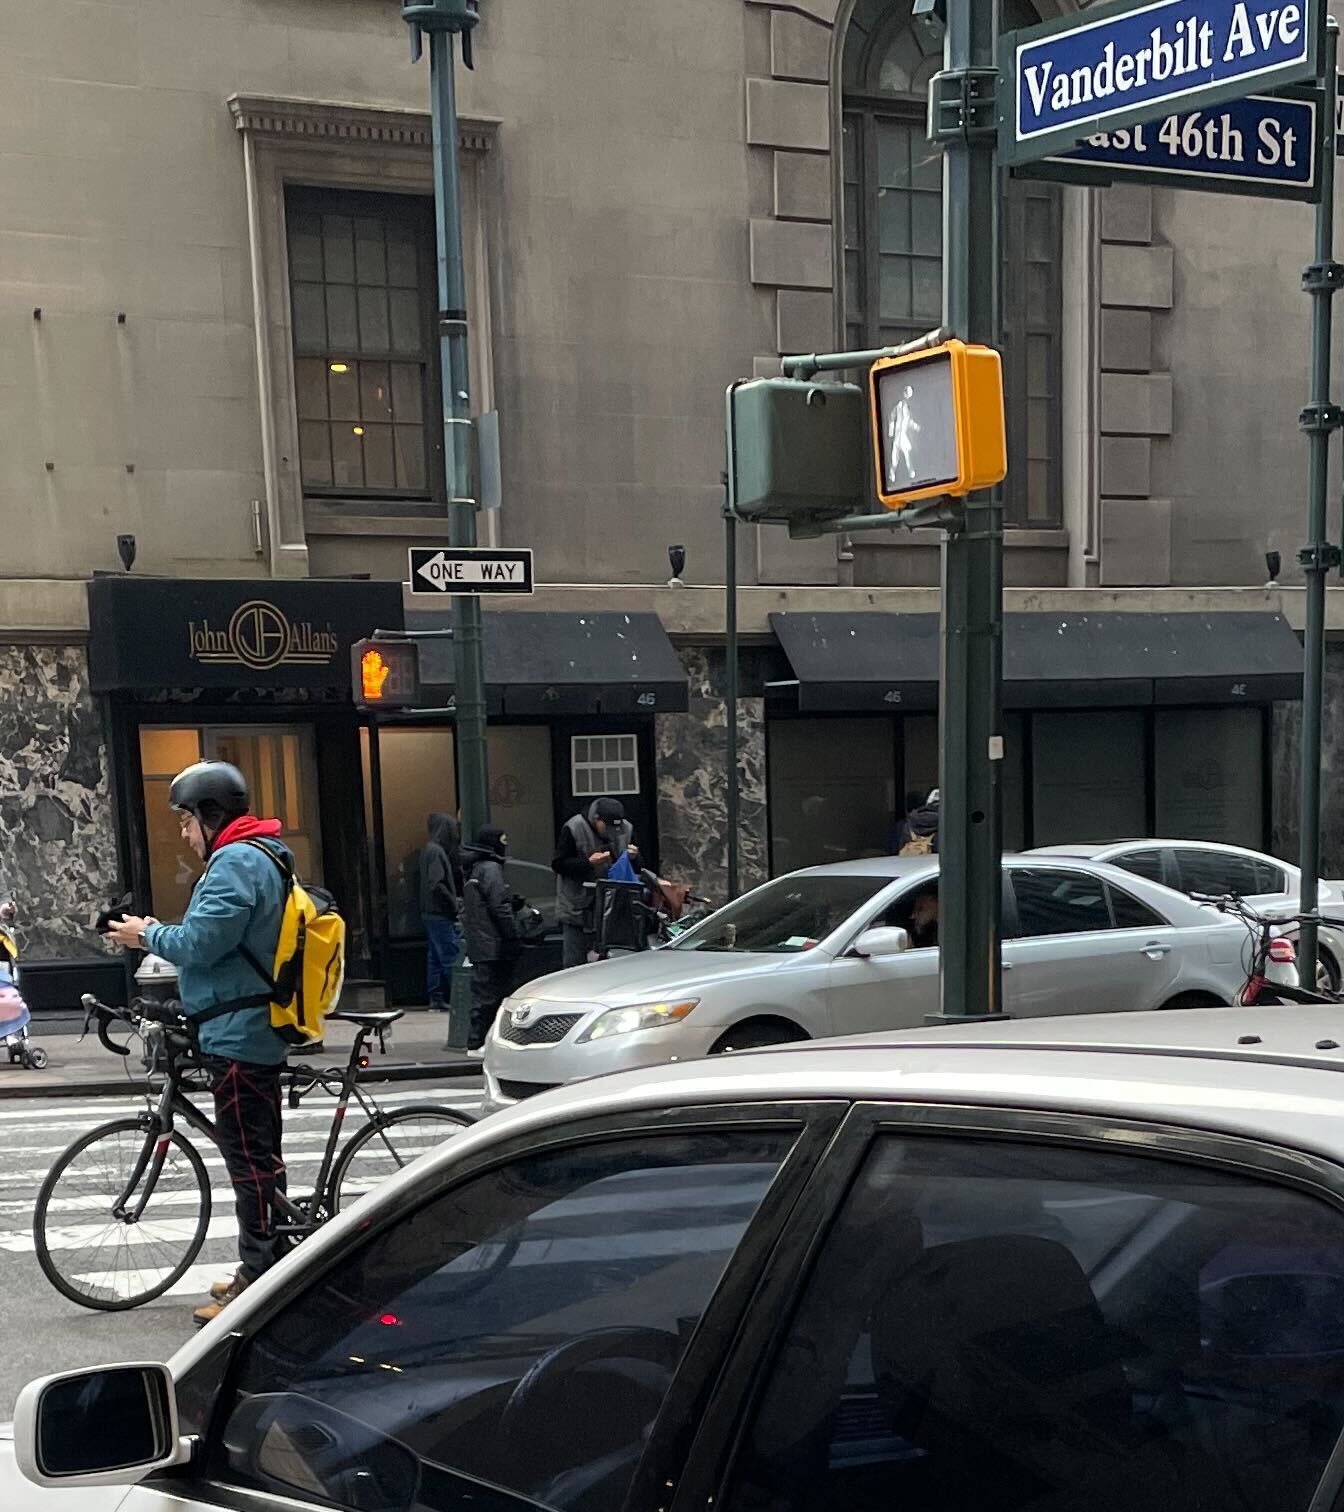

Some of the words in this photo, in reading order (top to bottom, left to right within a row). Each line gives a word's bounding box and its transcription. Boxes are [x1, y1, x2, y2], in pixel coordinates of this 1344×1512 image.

[1024, 16, 1214, 117] Vanderbilt
[1223, 3, 1301, 63] Ave
[1159, 111, 1244, 162] 46th
[1257, 118, 1297, 168] St
[430, 563, 464, 580] ONE
[481, 563, 516, 580] WAY
[189, 619, 228, 659] John
[290, 622, 338, 652] Allan's
